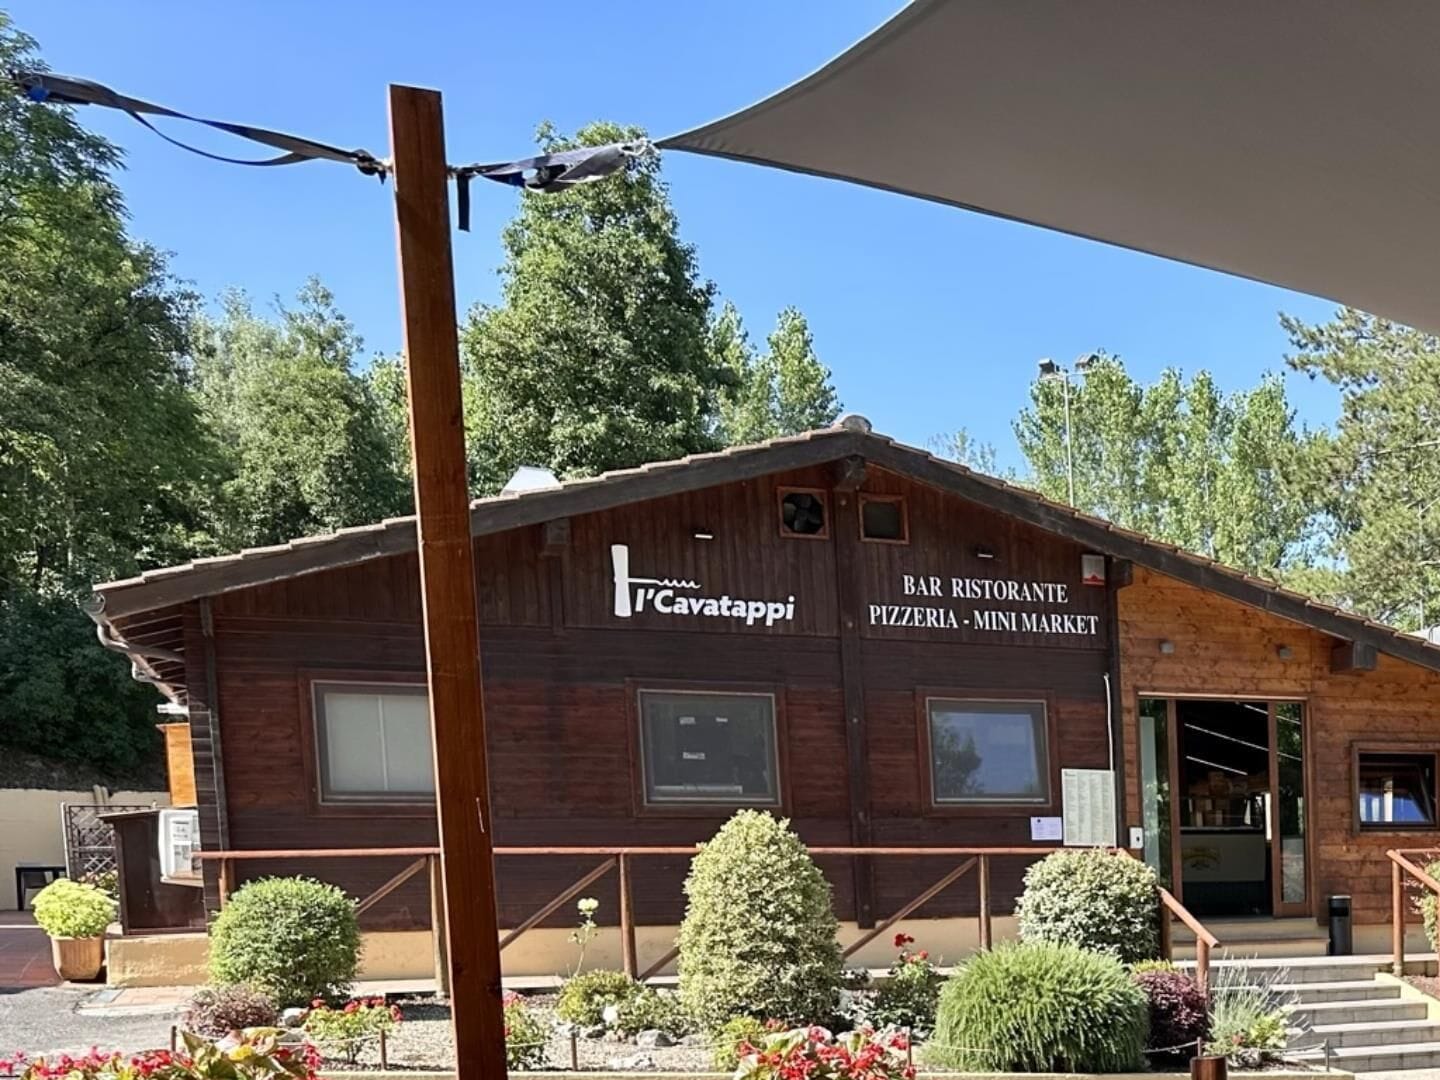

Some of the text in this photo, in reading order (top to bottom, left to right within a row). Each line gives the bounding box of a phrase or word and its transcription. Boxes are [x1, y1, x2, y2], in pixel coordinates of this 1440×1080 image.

[903, 574, 1069, 603] BAR RISTORANTE
[869, 604, 959, 629] PIZZERIA
[973, 610, 1018, 632] MINI
[1021, 611, 1099, 635] MARKET
